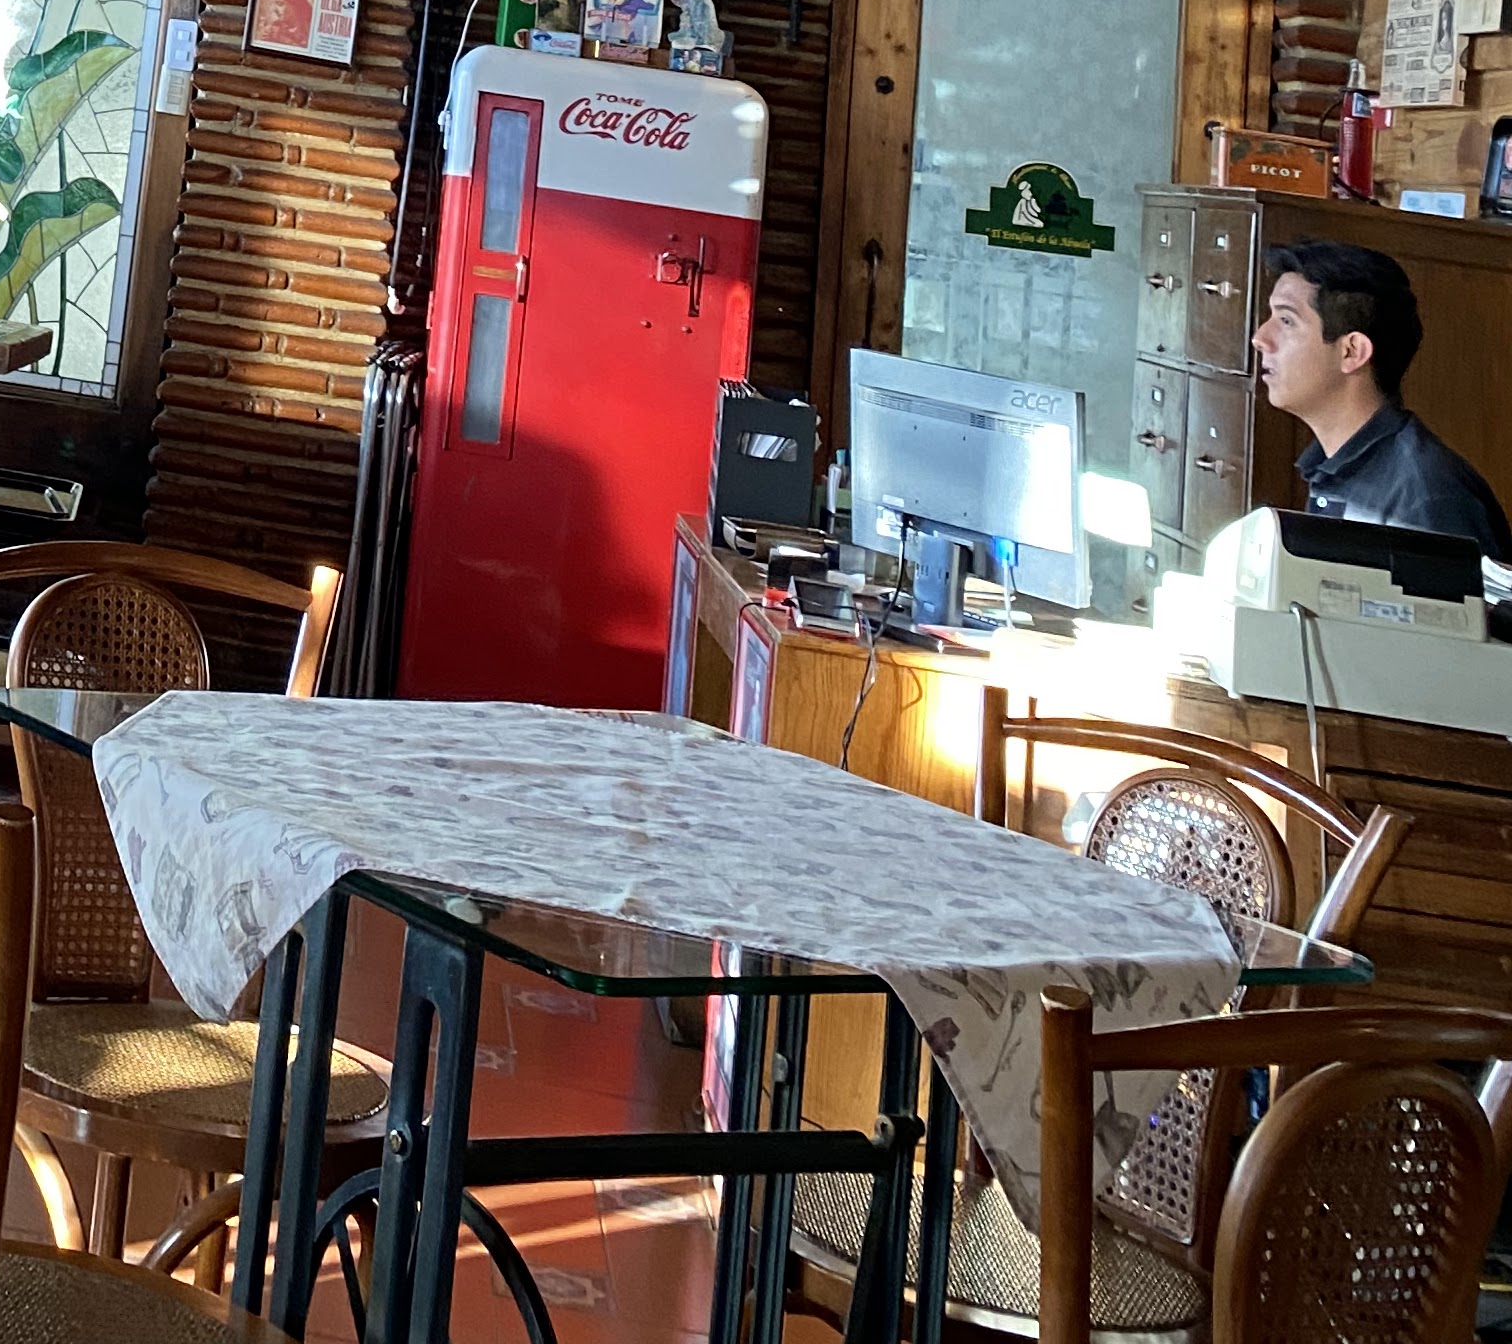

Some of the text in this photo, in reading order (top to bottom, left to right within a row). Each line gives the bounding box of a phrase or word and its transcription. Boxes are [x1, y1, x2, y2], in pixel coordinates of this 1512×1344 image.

[595, 92, 646, 108] TOME
[558, 97, 698, 151] Coca-Cola
[1010, 389, 1062, 415] acer
